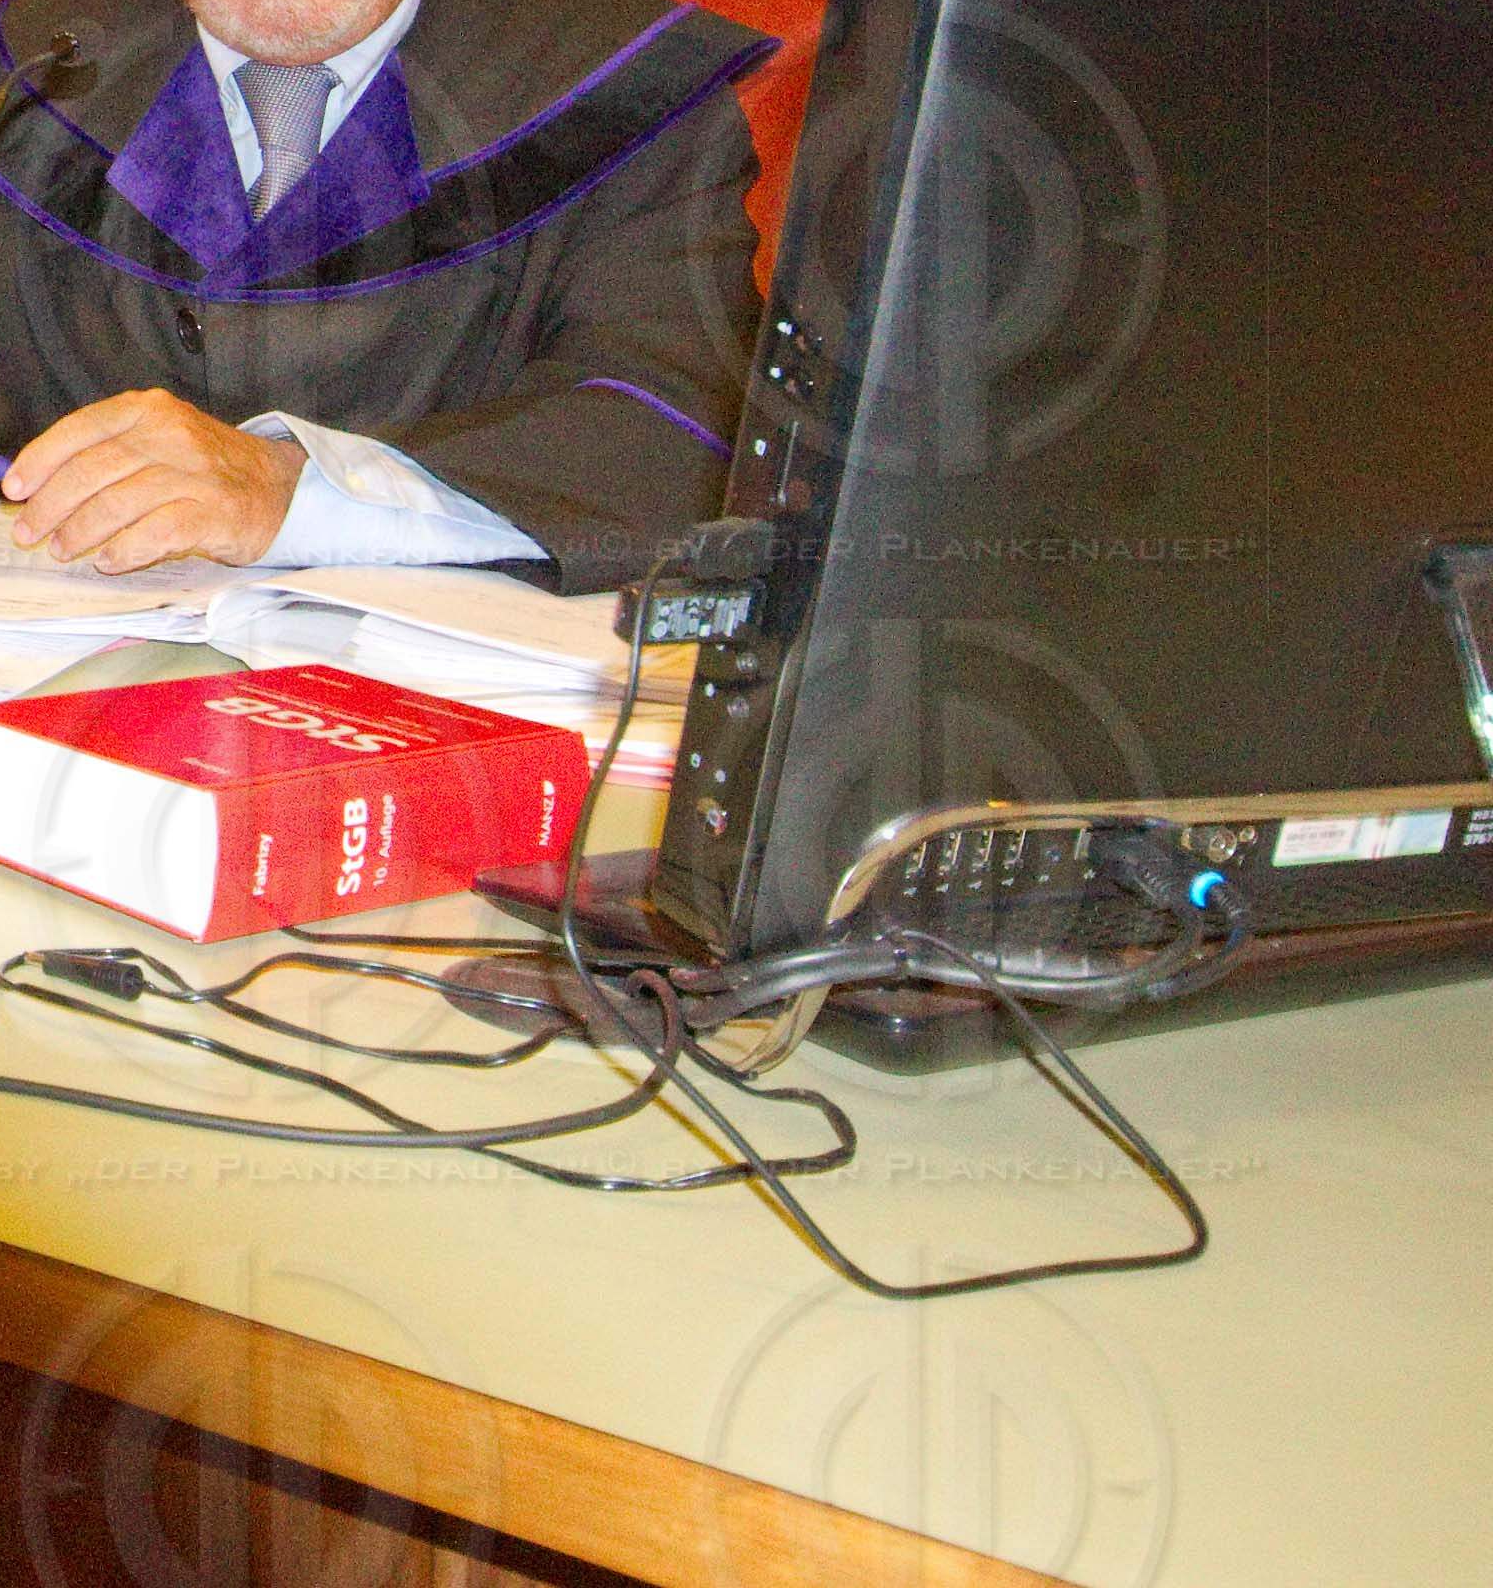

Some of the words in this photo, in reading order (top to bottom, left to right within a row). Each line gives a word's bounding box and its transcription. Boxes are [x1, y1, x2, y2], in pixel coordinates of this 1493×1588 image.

[203, 695, 409, 754] StGB
[336, 798, 368, 898] StGB
[377, 794, 394, 859] Auflage
[539, 797, 554, 847] MANZ
[253, 833, 270, 897] Fabrizy
[373, 864, 386, 889] 10.
